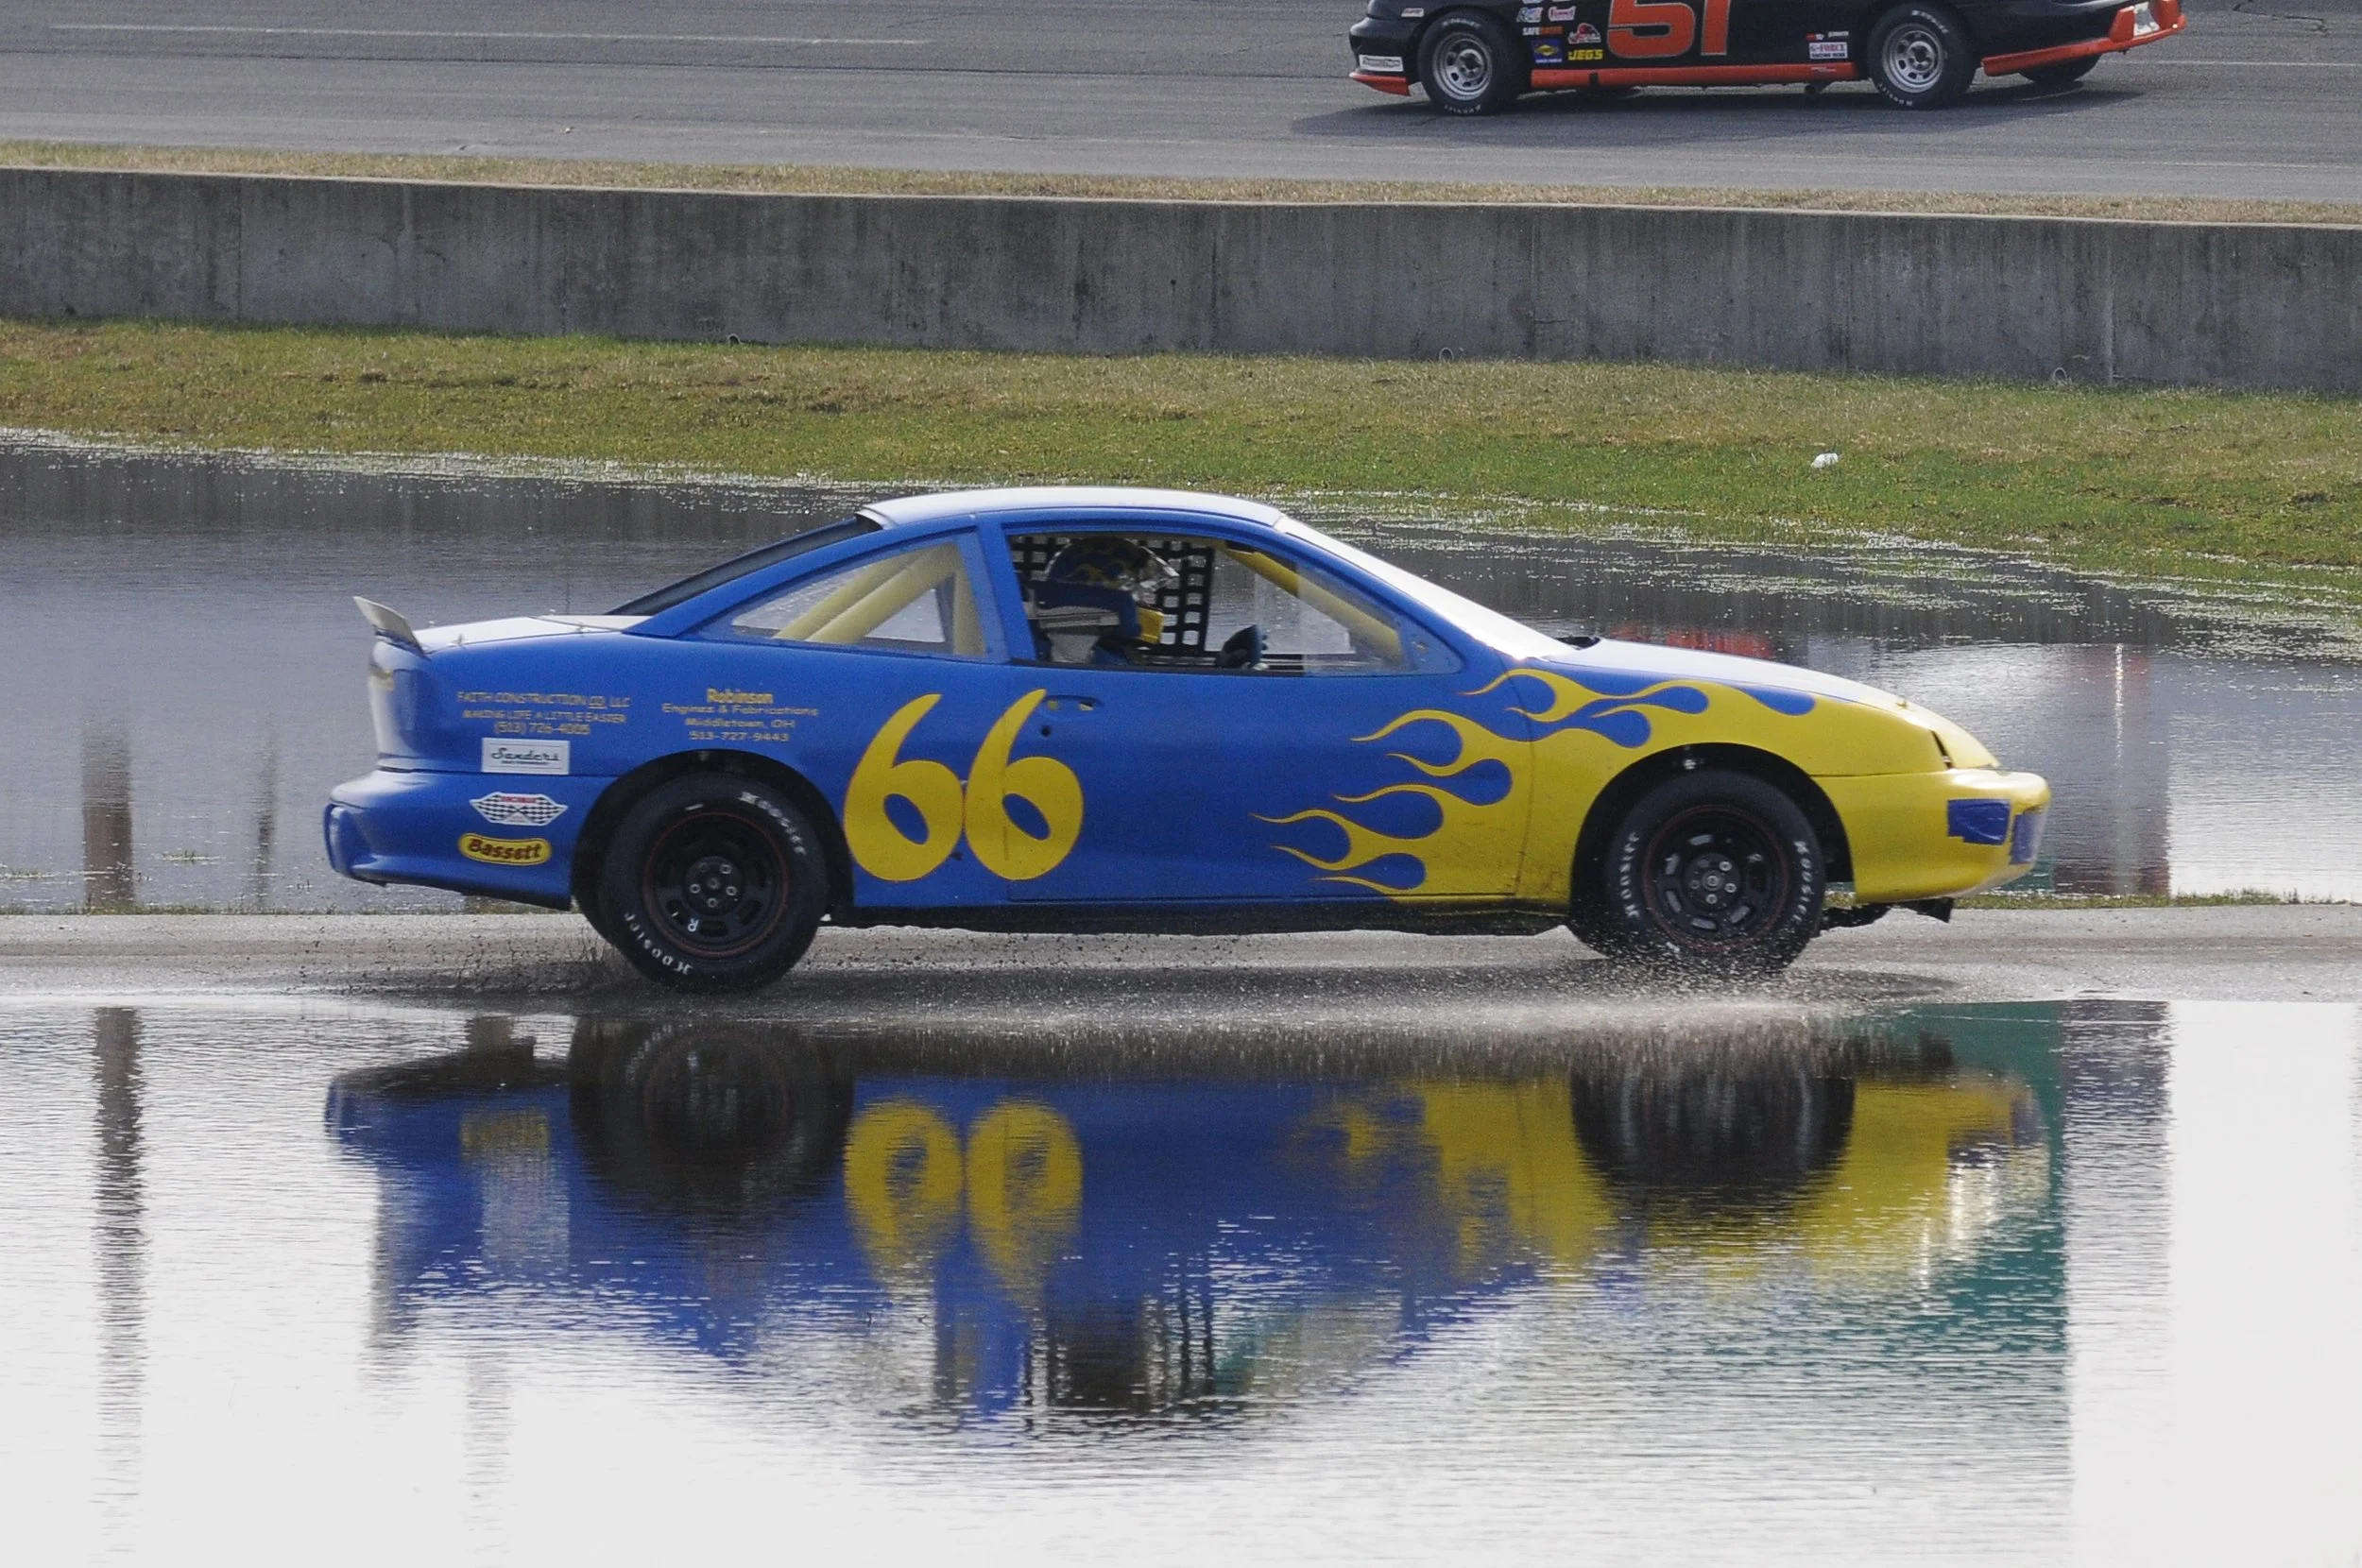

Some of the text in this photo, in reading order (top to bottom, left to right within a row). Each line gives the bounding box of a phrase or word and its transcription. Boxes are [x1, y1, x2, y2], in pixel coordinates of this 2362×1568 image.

[496, 692, 587, 706] CONSTRUCTION
[609, 697, 632, 707] LLC
[707, 688, 774, 704] Robinson
[771, 719, 796, 728] OH
[491, 747, 561, 761] Sanders
[844, 689, 1084, 881] 66
[469, 838, 542, 860] Bassett
